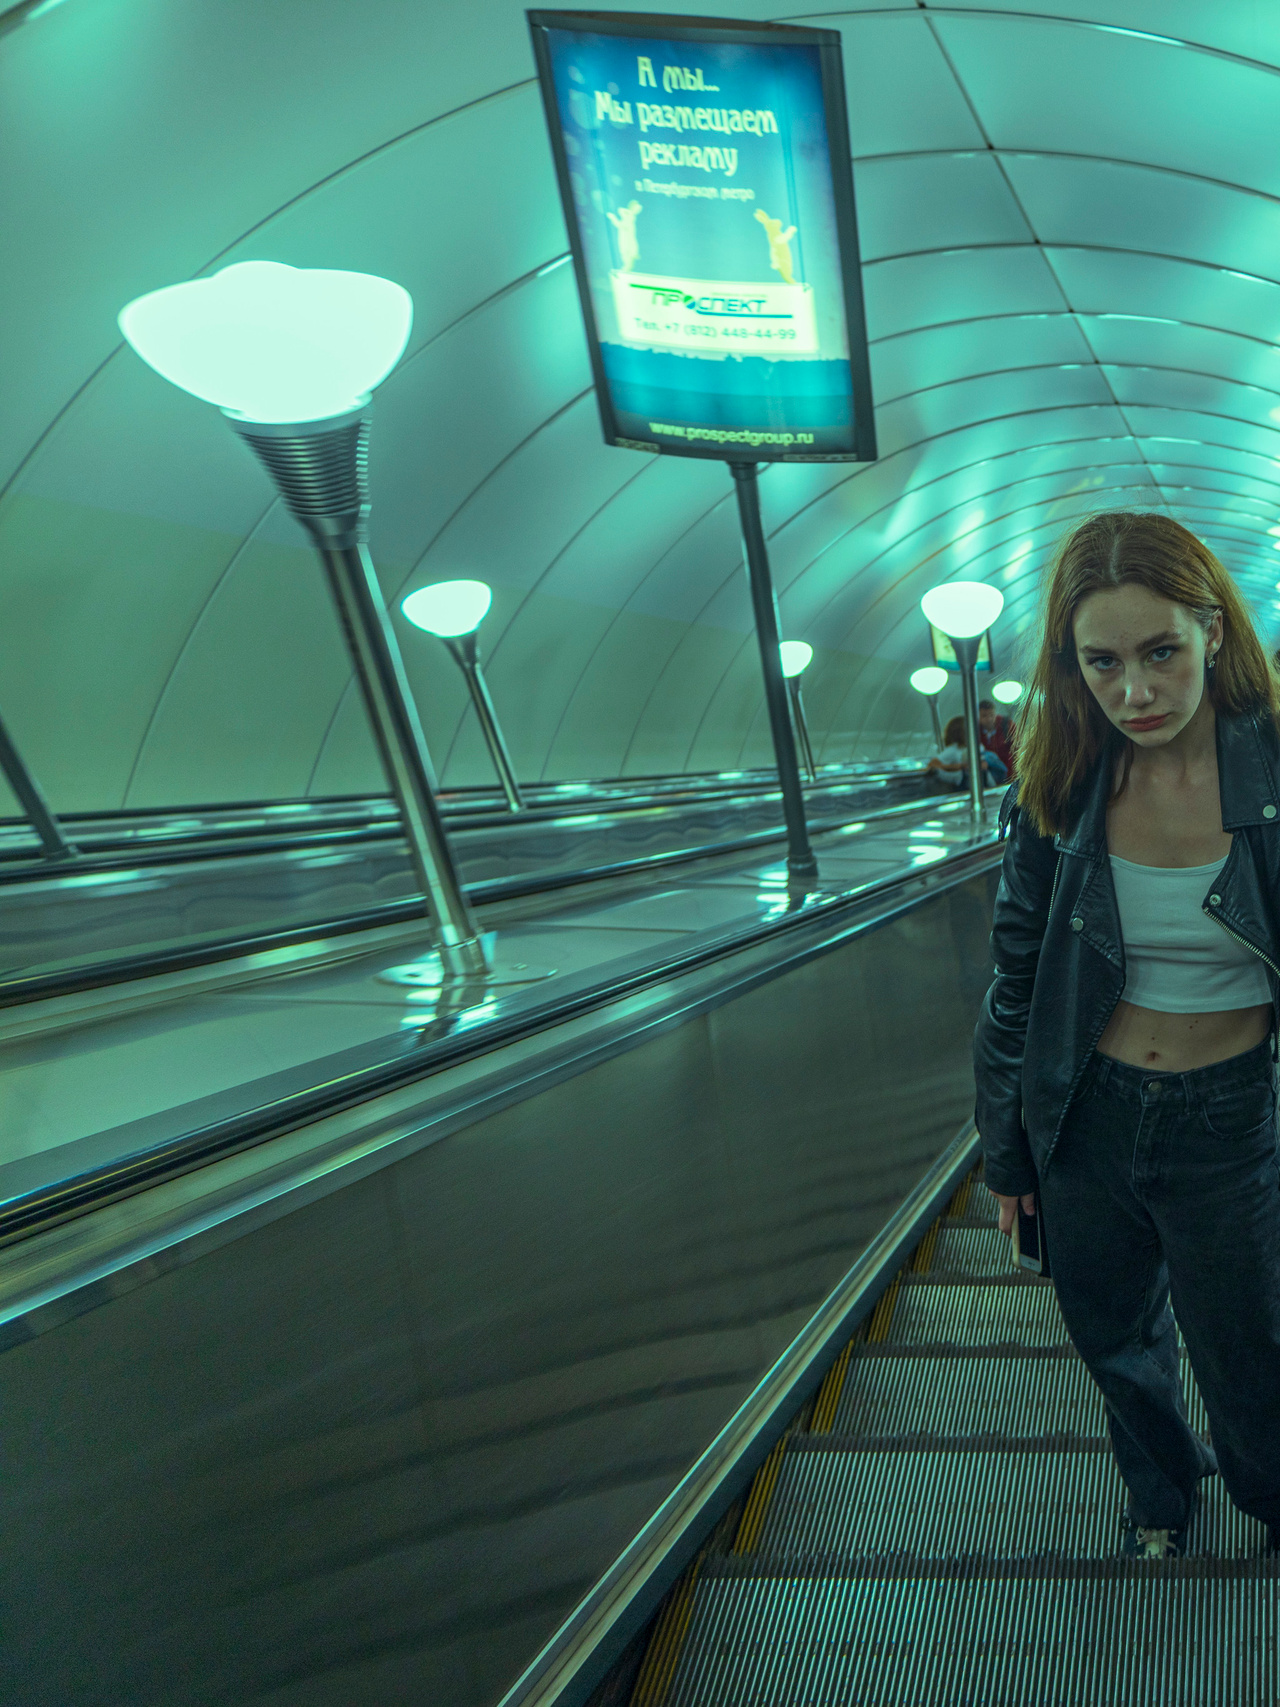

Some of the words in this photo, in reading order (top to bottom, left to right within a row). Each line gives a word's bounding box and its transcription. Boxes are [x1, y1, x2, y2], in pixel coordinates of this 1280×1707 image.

[636, 56, 658, 88] А
[594, 90, 634, 125] Мы
[635, 102, 779, 137] размещаем
[637, 140, 739, 177] рекламу
[651, 291, 767, 313] ПРОСПЕКТ
[682, 323, 718, 338] (812)
[721, 327, 797, 340] 448-44-99
[649, 422, 814, 446] www.prospectgroup.ru
